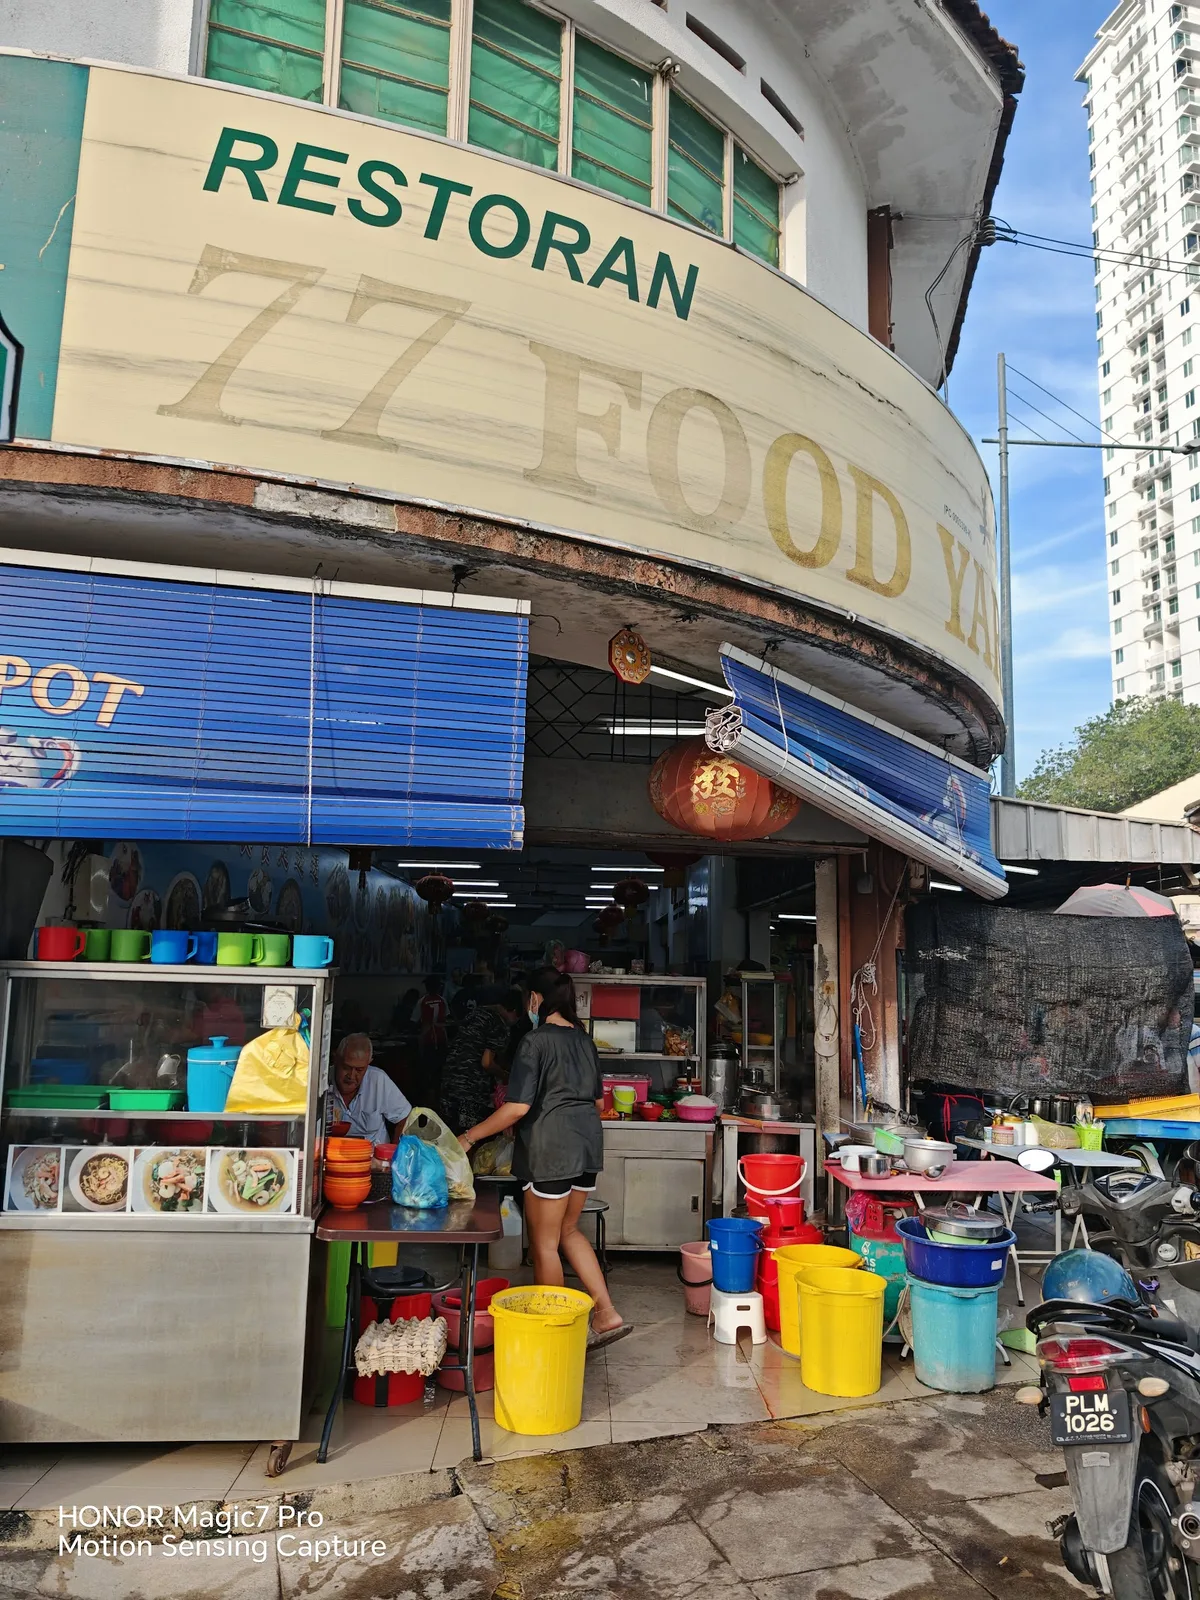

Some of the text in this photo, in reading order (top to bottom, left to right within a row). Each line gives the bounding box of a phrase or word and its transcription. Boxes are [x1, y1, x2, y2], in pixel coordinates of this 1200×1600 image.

[203, 127, 699, 321] RESTORAN
[157, 244, 472, 453] 77
[524, 340, 912, 598] FOOD
[1064, 1413, 1115, 1433] 1026
[1066, 1393, 1110, 1414] PLM
